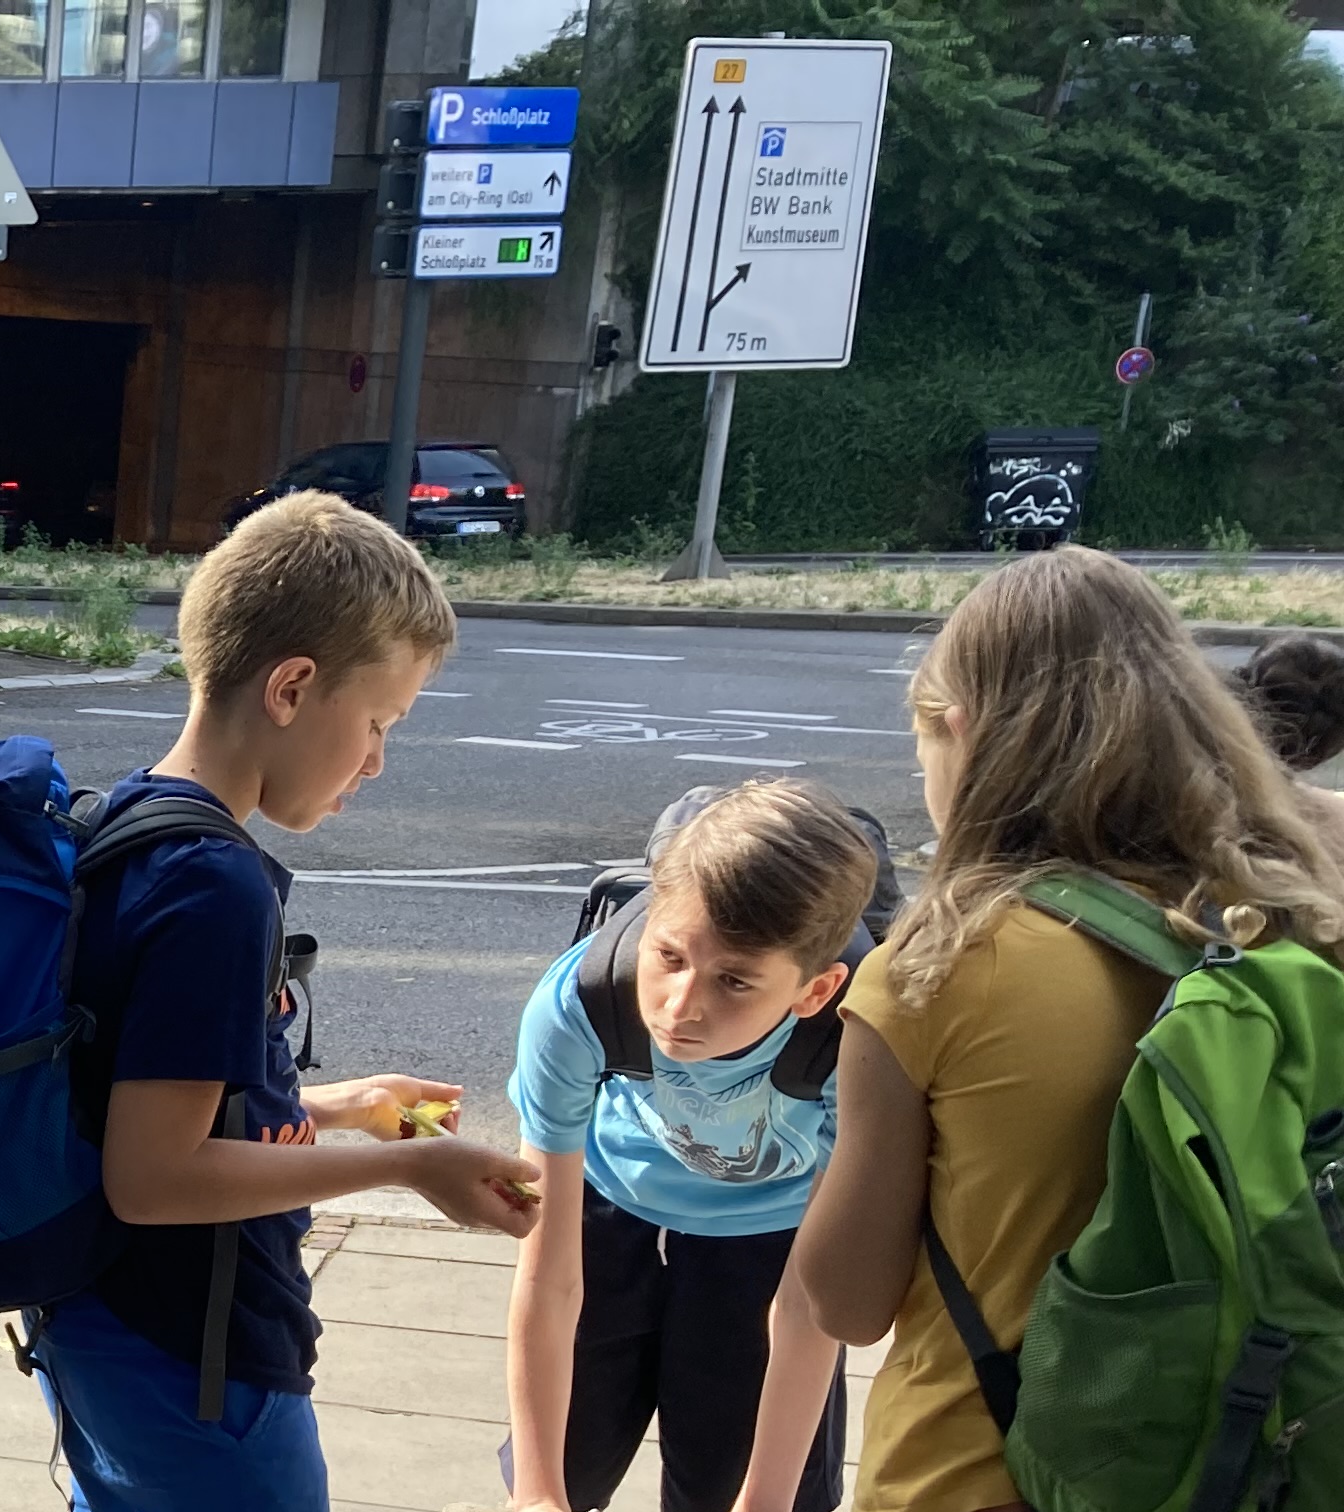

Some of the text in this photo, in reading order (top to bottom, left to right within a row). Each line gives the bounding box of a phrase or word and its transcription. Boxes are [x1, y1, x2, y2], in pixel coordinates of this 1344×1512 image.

[722, 63, 739, 79] 27
[437, 93, 551, 139] P Schloßplatz
[431, 168, 474, 181] weitere
[755, 167, 848, 186] Stadtmitte
[427, 190, 533, 208] am City-Ring (Ost)
[750, 195, 833, 215] BW Bank
[422, 235, 464, 249] Kleiner
[746, 224, 840, 244] Kunstmuseum
[421, 256, 486, 271] Schloßplatz
[726, 332, 767, 351] 75 m
